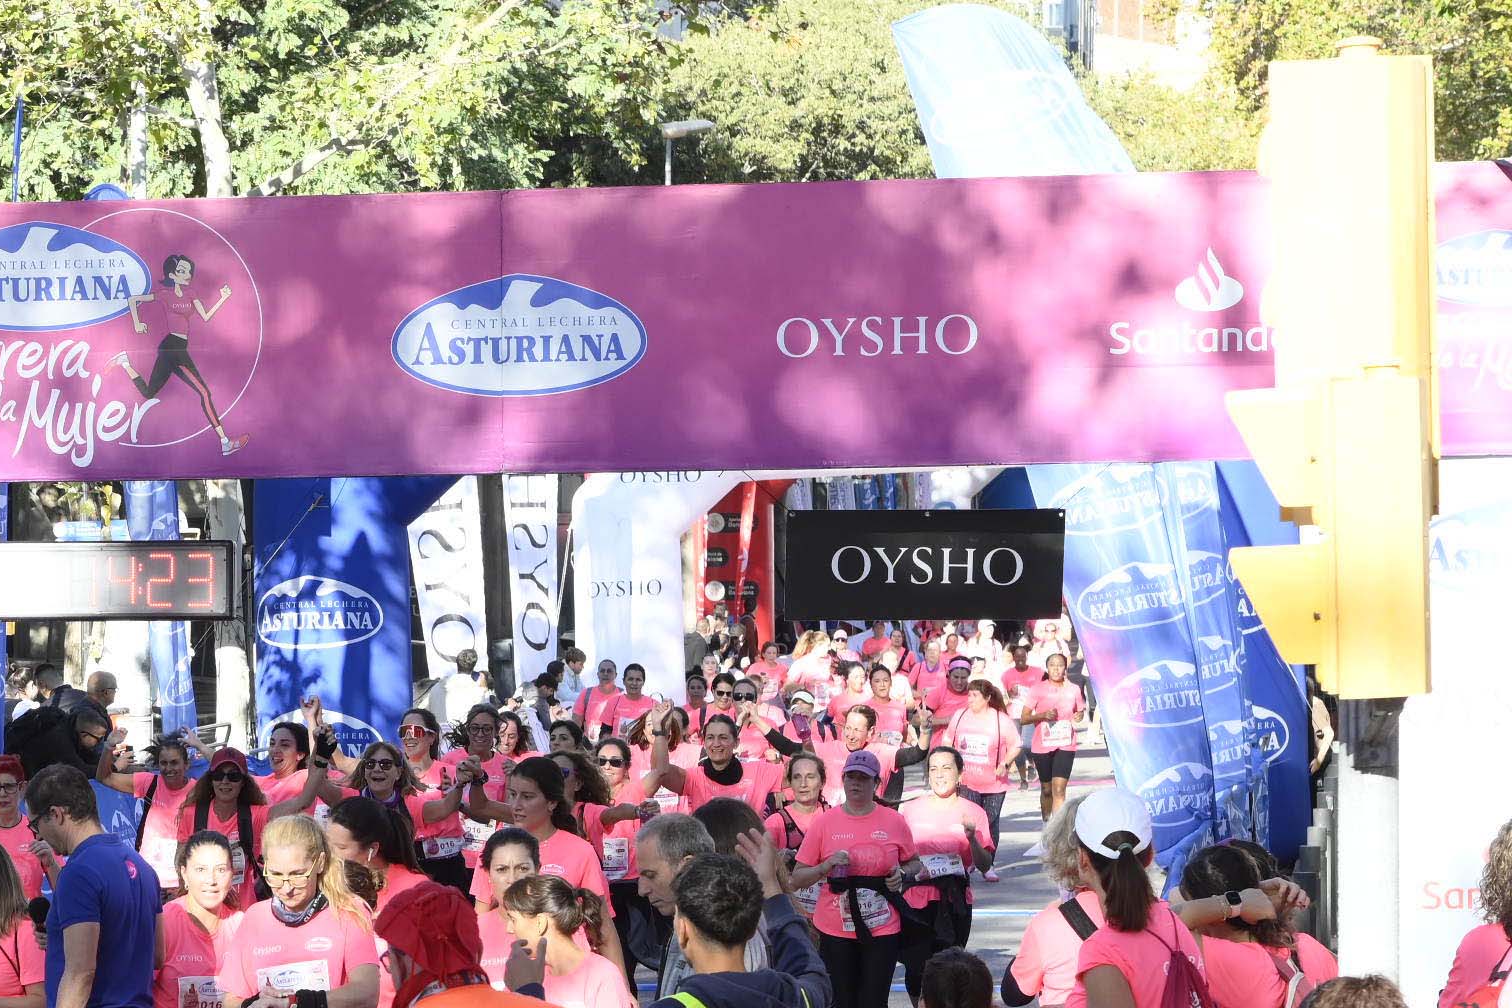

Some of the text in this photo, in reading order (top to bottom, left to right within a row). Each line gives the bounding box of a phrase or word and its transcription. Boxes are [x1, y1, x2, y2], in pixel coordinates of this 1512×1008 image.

[54, 257, 126, 270] LECHERA
[450, 314, 619, 330] CENTRAL LECHERA
[412, 322, 628, 366] ASTURIANA
[776, 314, 978, 357] OYSHO
[12, 374, 160, 468] Mujer
[620, 470, 701, 483] OYSHO
[831, 546, 1024, 586] OYSHO
[590, 578, 662, 598] OYSHO
[273, 599, 369, 610] CENTRAL LECHERA
[261, 605, 374, 632] ASTURIANA
[440, 841, 455, 850] 016
[930, 866, 948, 876] 016
